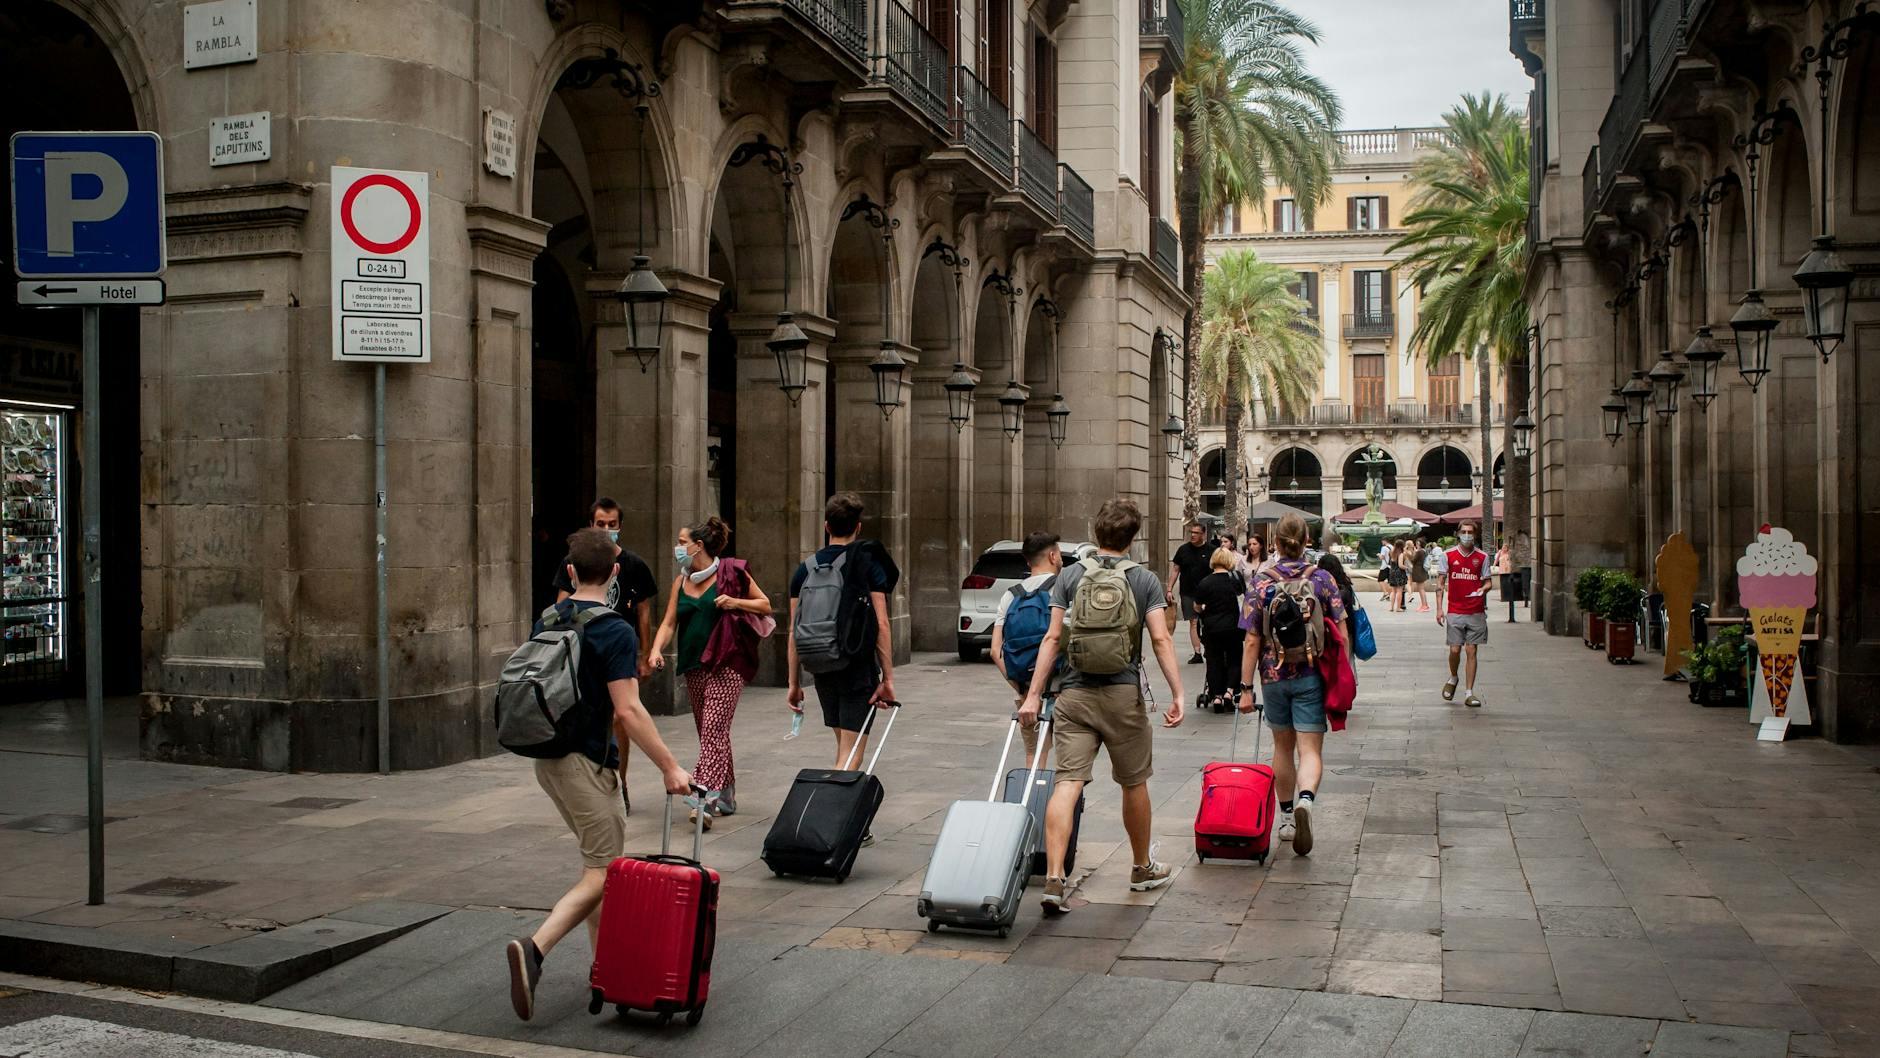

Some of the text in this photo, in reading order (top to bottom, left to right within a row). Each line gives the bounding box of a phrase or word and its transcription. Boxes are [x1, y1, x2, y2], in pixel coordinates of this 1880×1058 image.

[212, 16, 225, 27] LA
[196, 35, 242, 52] RAMBLA
[223, 119, 255, 131] RAMBLA
[229, 131, 249, 141] DELS
[215, 140, 263, 156] CAPUTXINS
[44, 151, 129, 257] P
[367, 263, 397, 273] 0-24 h
[100, 285, 137, 299] Hotel
[359, 285, 382, 293] Excepte
[353, 301, 372, 309] Temps
[1760, 612, 1794, 625] Gelats
